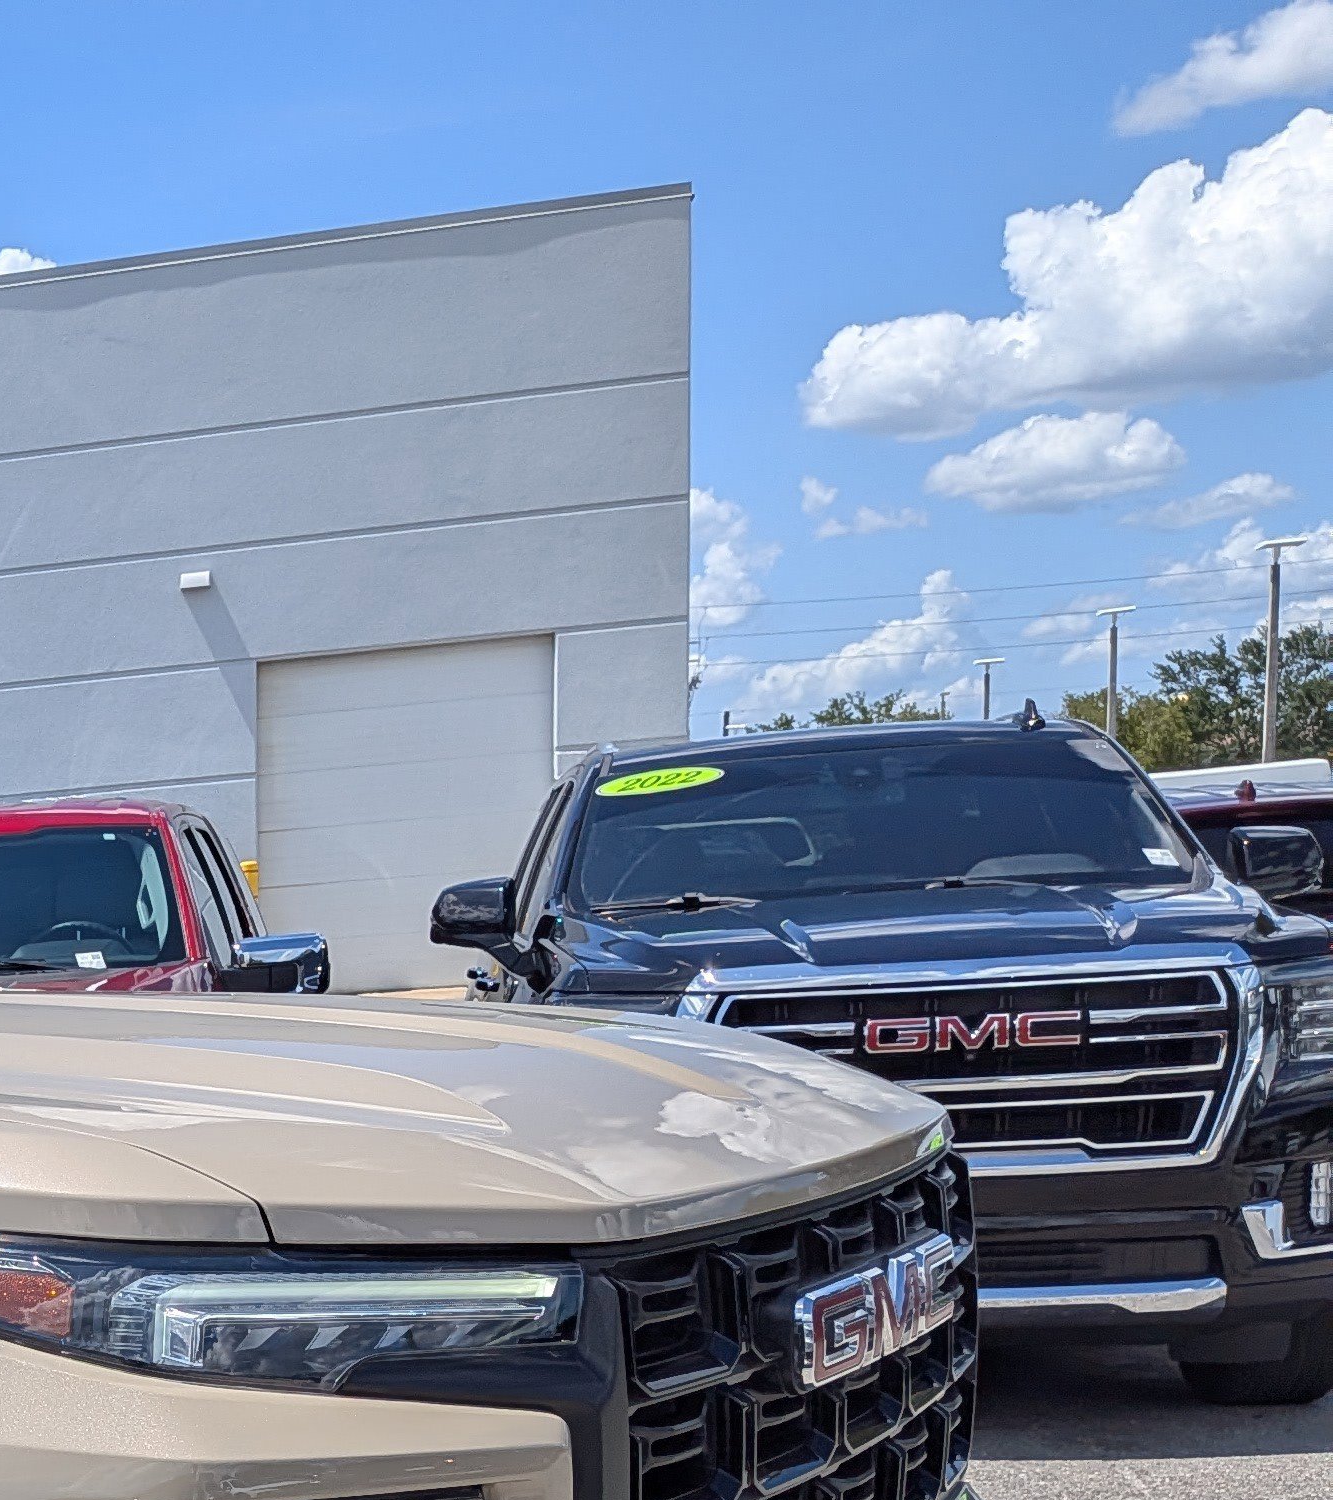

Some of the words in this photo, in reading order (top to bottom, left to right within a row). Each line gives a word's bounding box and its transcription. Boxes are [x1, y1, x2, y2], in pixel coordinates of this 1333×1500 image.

[616, 770, 703, 793] 2022
[863, 1010, 1081, 1055] GMC
[797, 1233, 955, 1388] GMC
